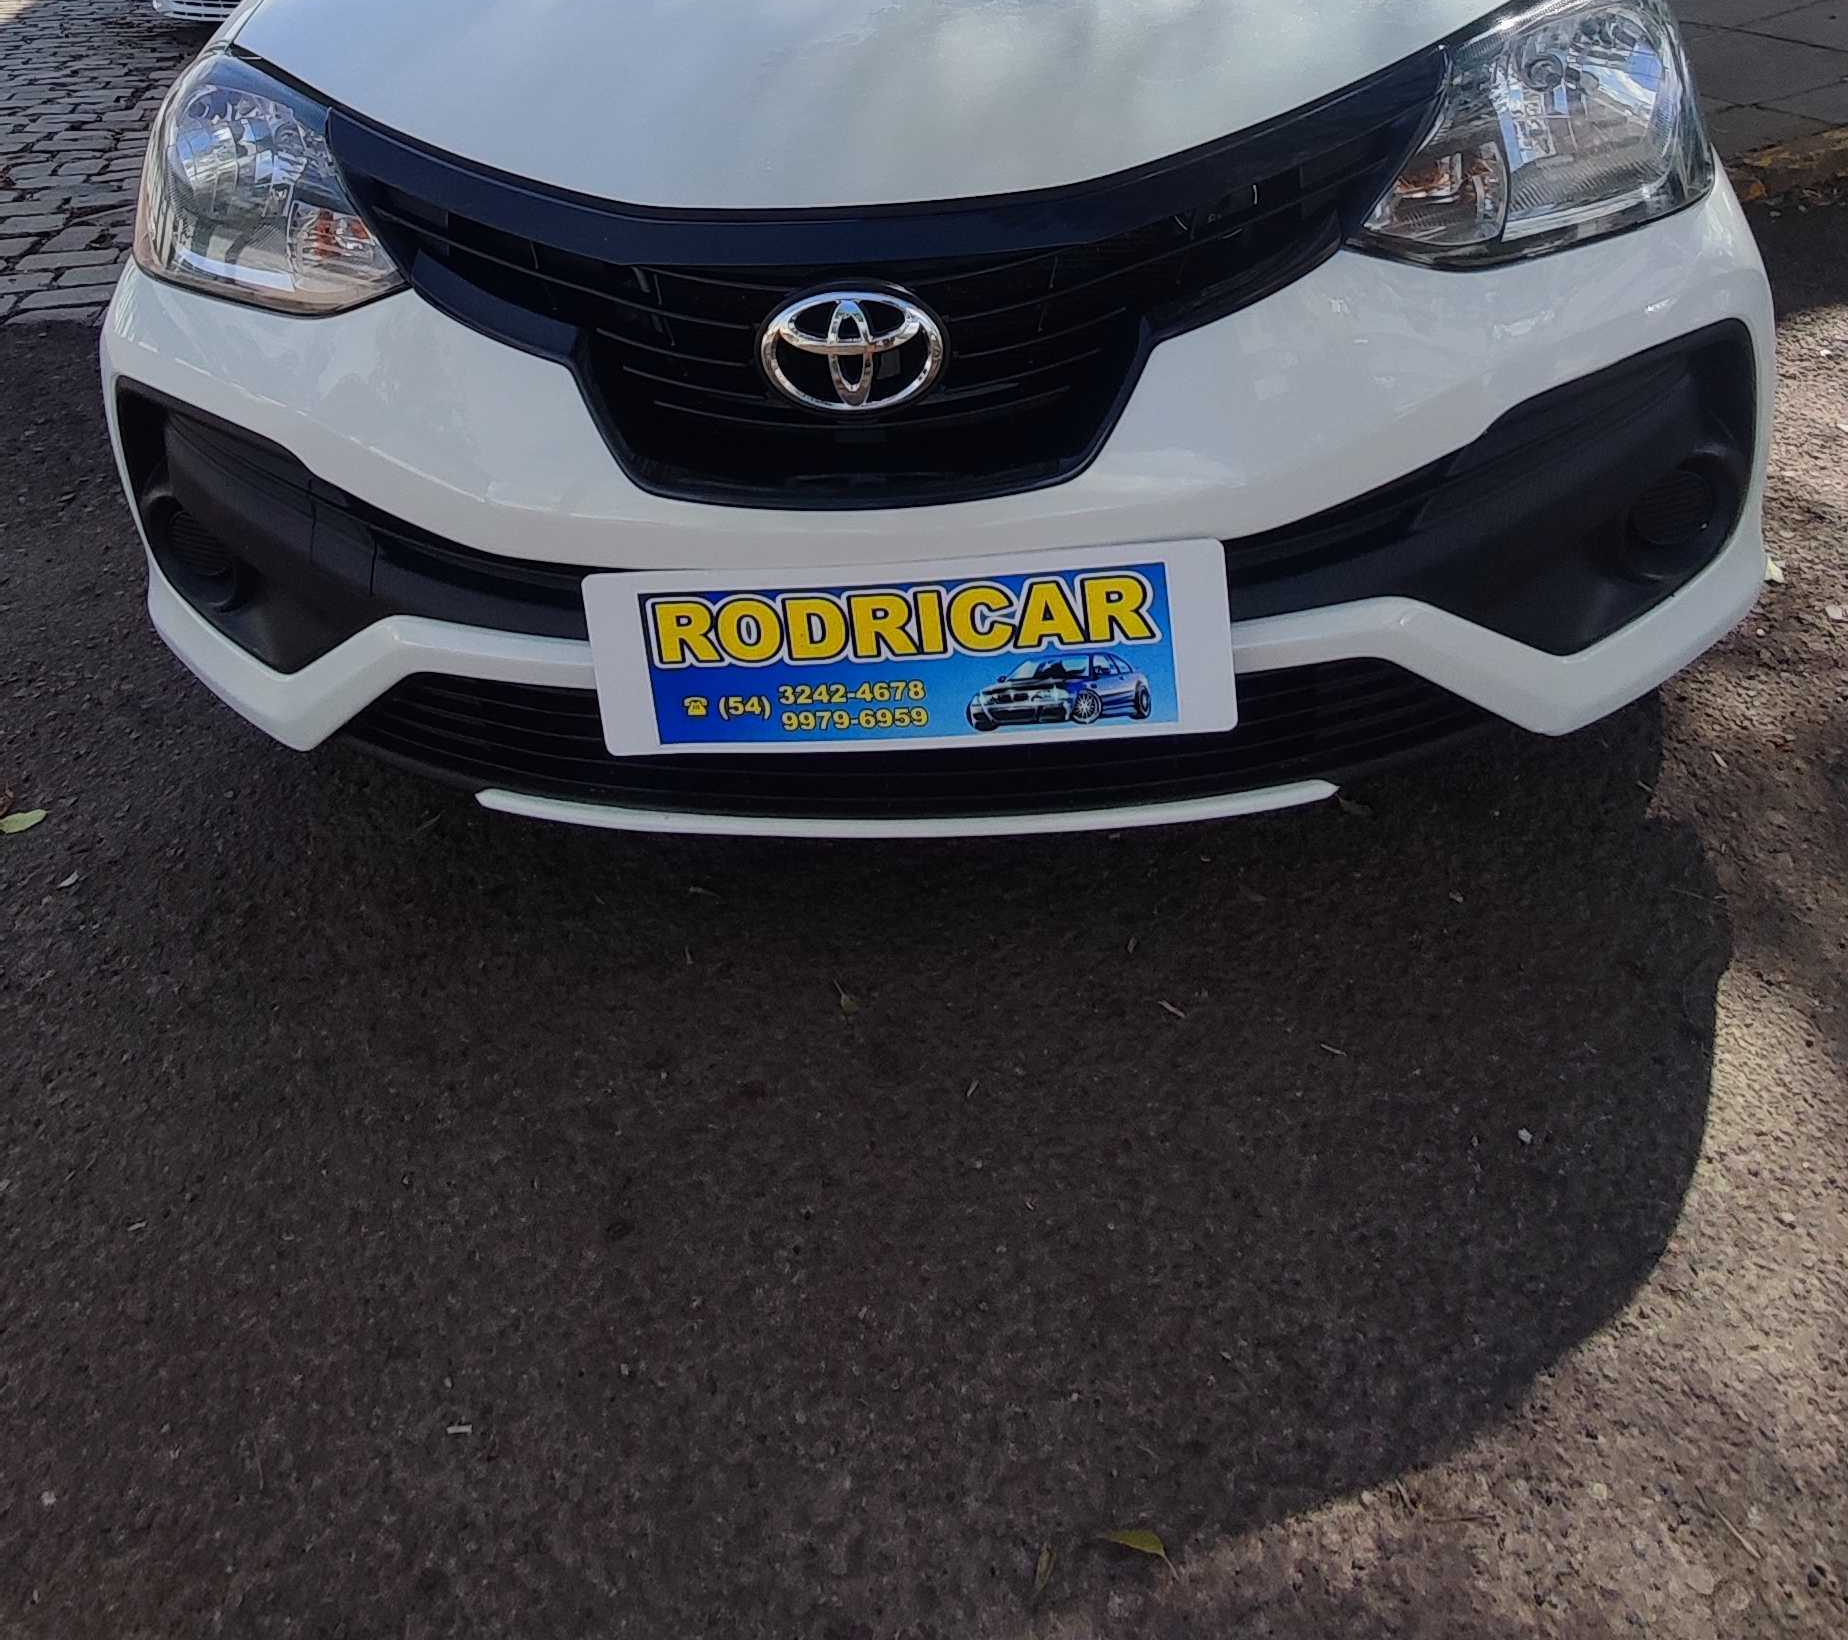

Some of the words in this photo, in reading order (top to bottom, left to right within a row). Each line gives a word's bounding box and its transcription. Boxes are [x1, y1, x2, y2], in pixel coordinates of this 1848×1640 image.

[651, 574, 1158, 666] RODRICAR
[778, 679, 927, 706] 3242-4678
[718, 696, 772, 721] (54)
[781, 706, 930, 731] 9979-6959
